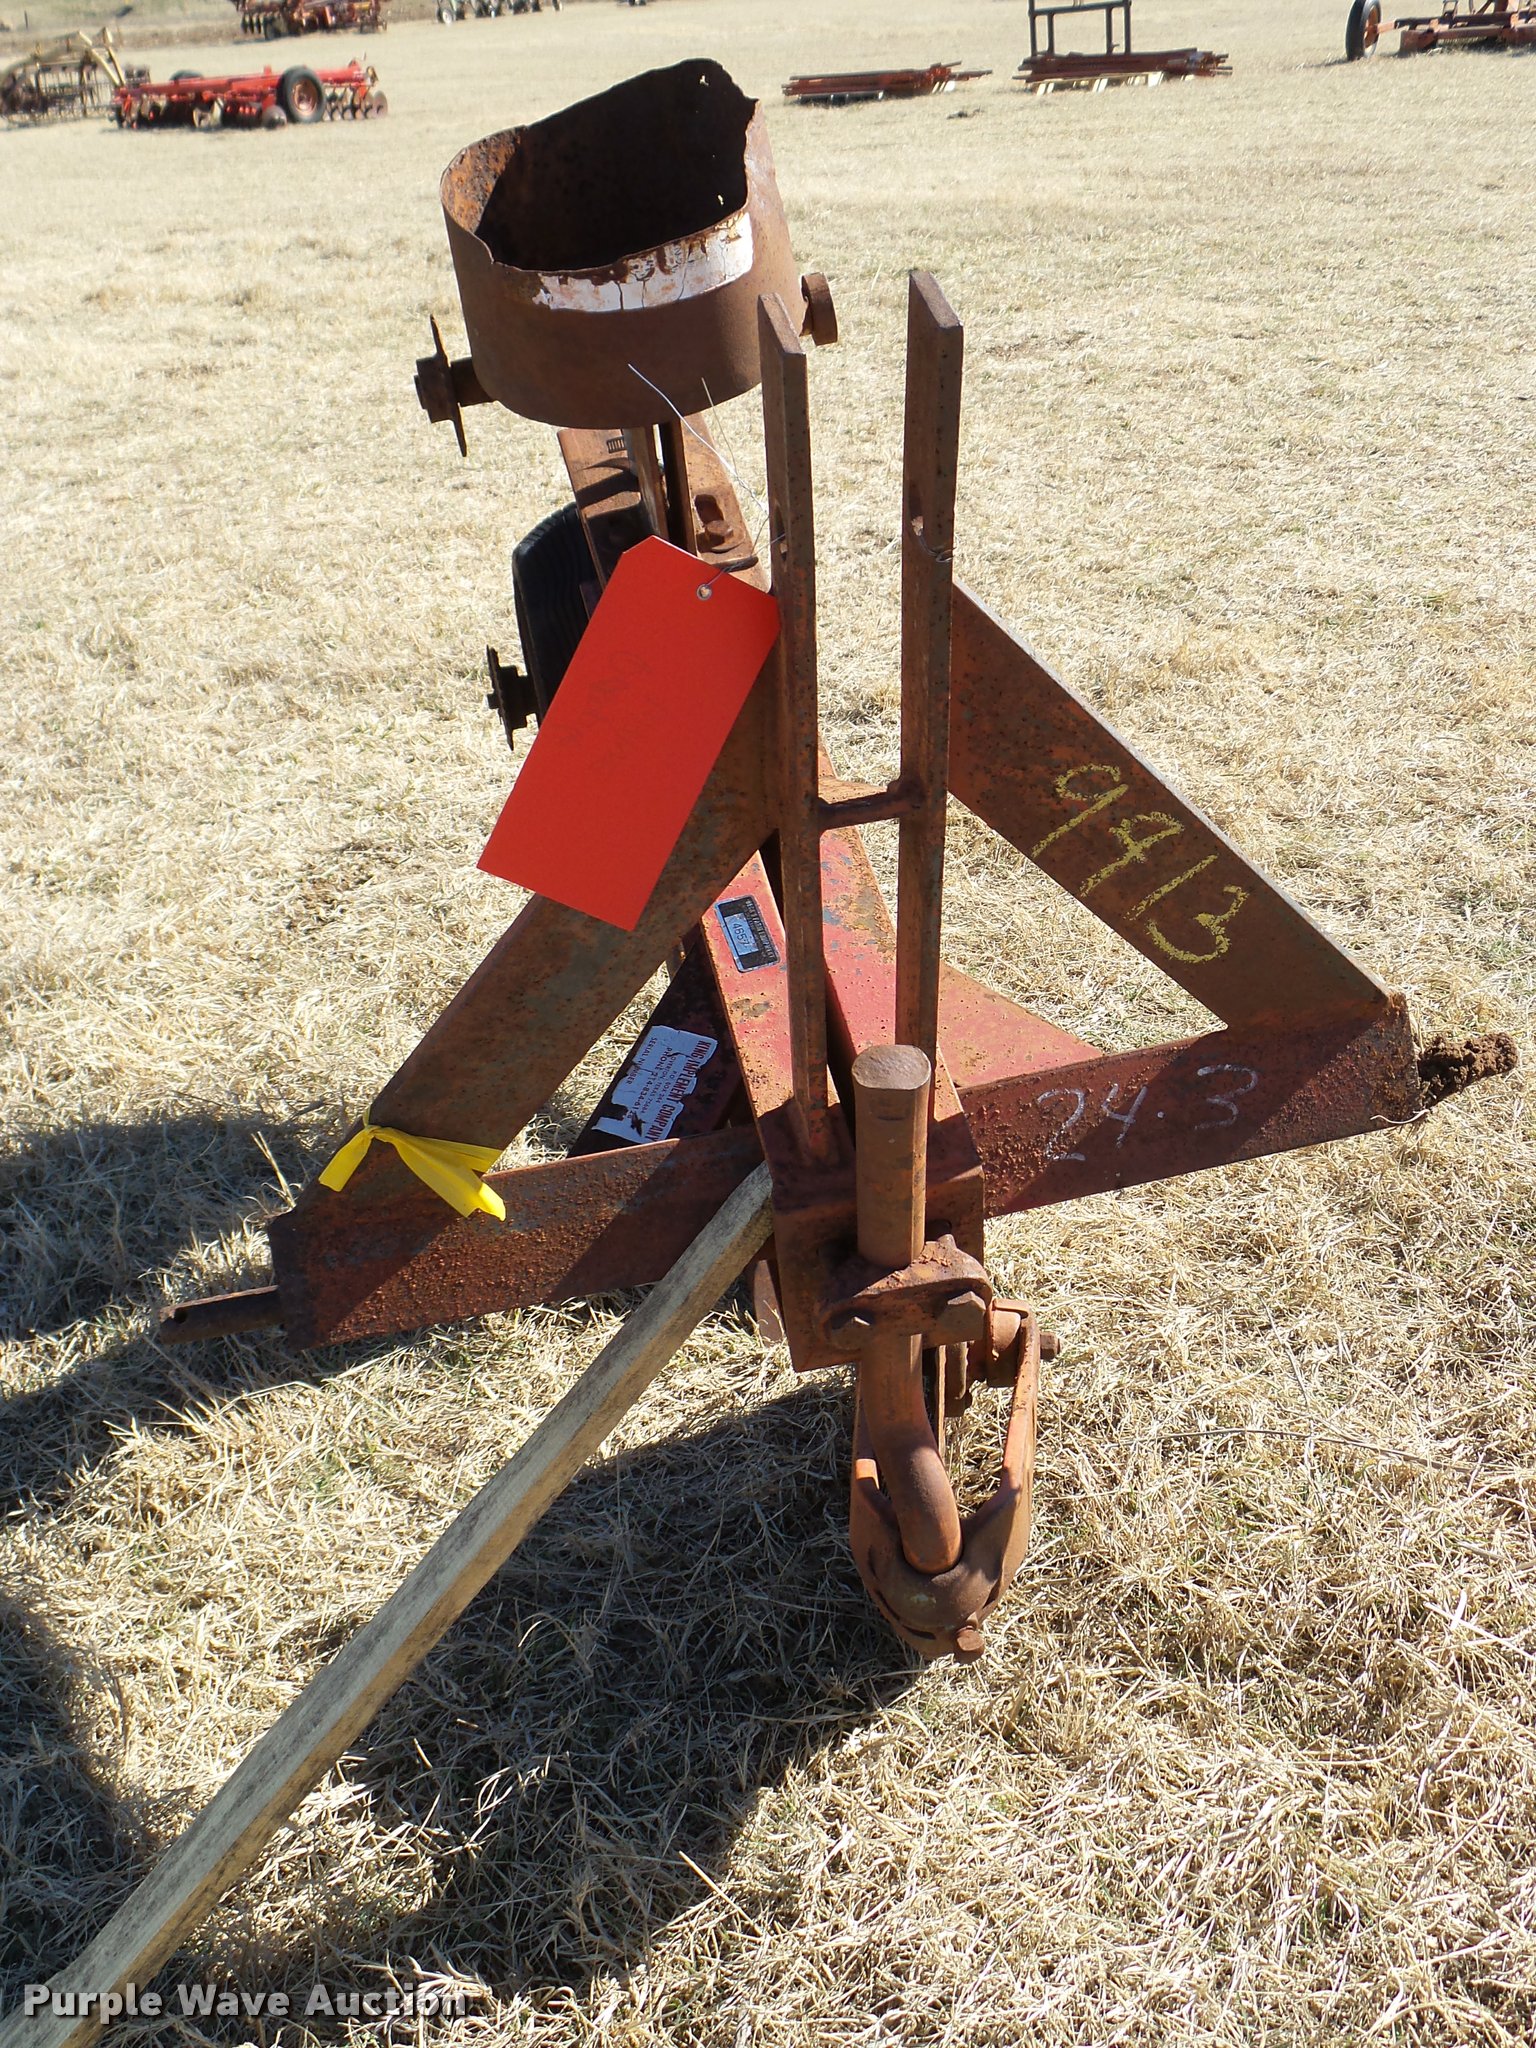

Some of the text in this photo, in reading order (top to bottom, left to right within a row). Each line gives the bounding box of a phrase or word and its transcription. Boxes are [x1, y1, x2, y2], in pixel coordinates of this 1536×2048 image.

[642, 1037, 658, 1057] SERIAL
[655, 1047, 672, 1071] PHONE
[645, 1040, 711, 1142] KING IMPLEMENT COMPANY
